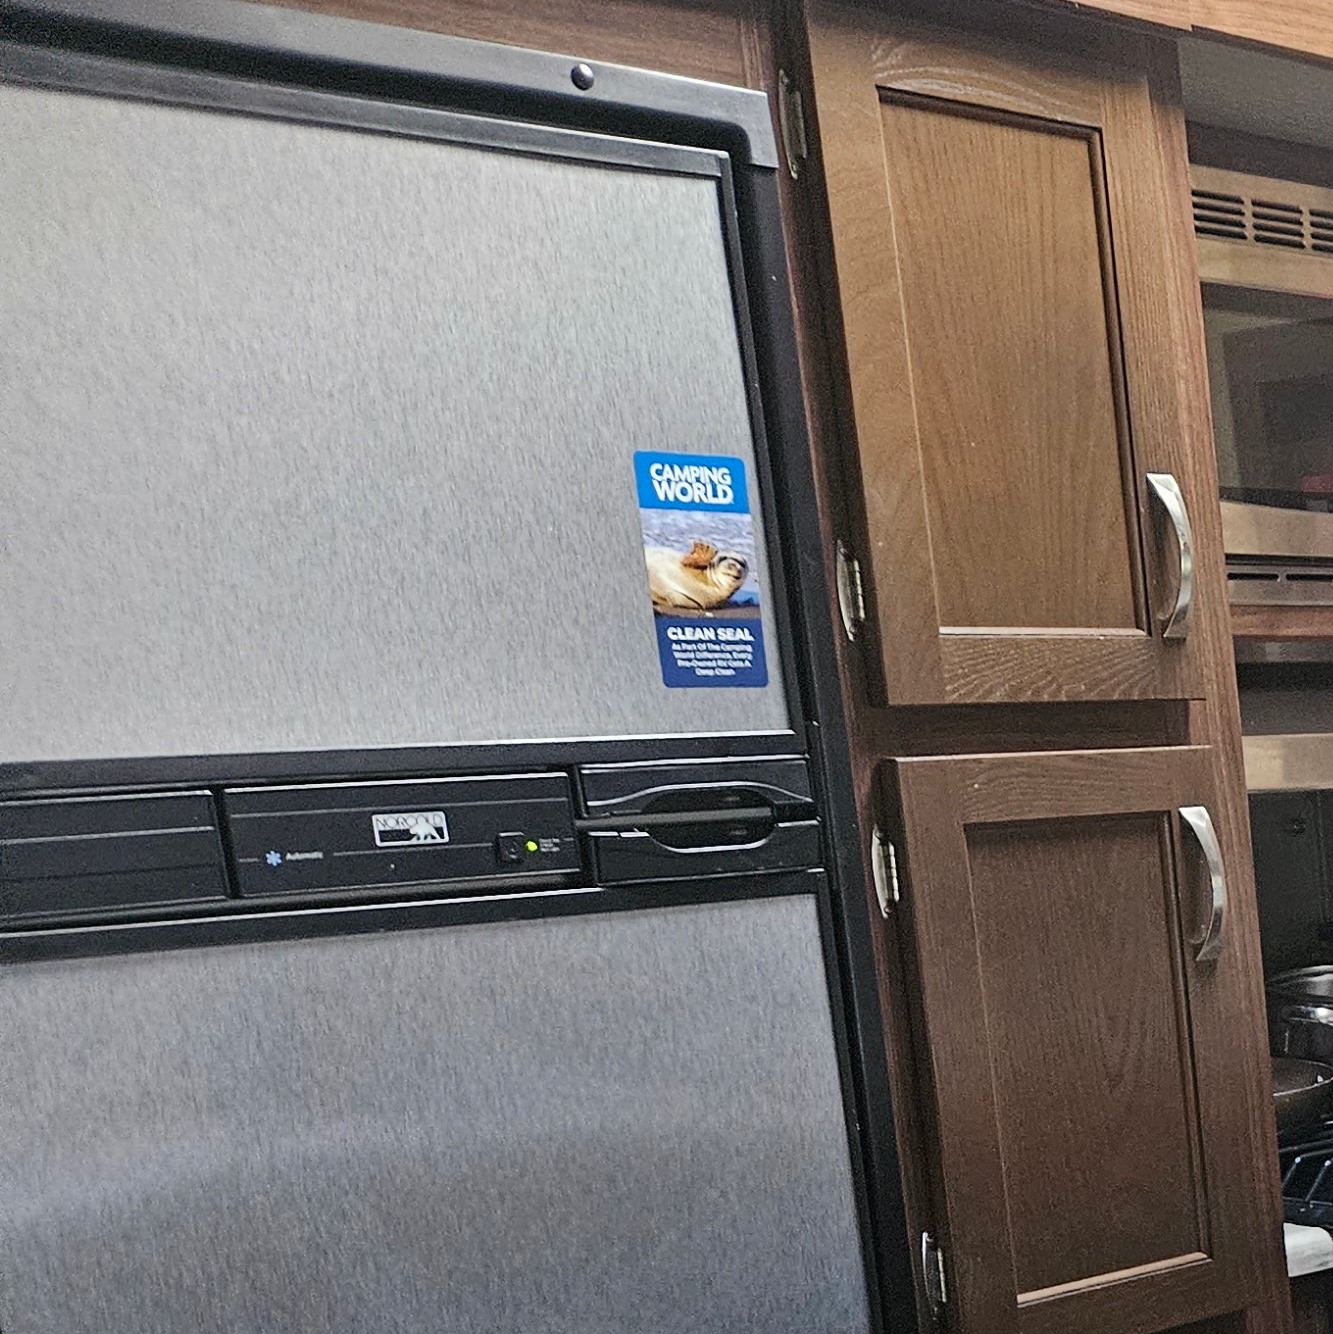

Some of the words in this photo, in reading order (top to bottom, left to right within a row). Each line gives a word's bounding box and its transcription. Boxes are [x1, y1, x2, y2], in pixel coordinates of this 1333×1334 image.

[649, 462, 732, 486] CAMPING
[651, 478, 734, 505] WORLD
[667, 626, 717, 640] CLEAN
[717, 627, 755, 641] SEAL
